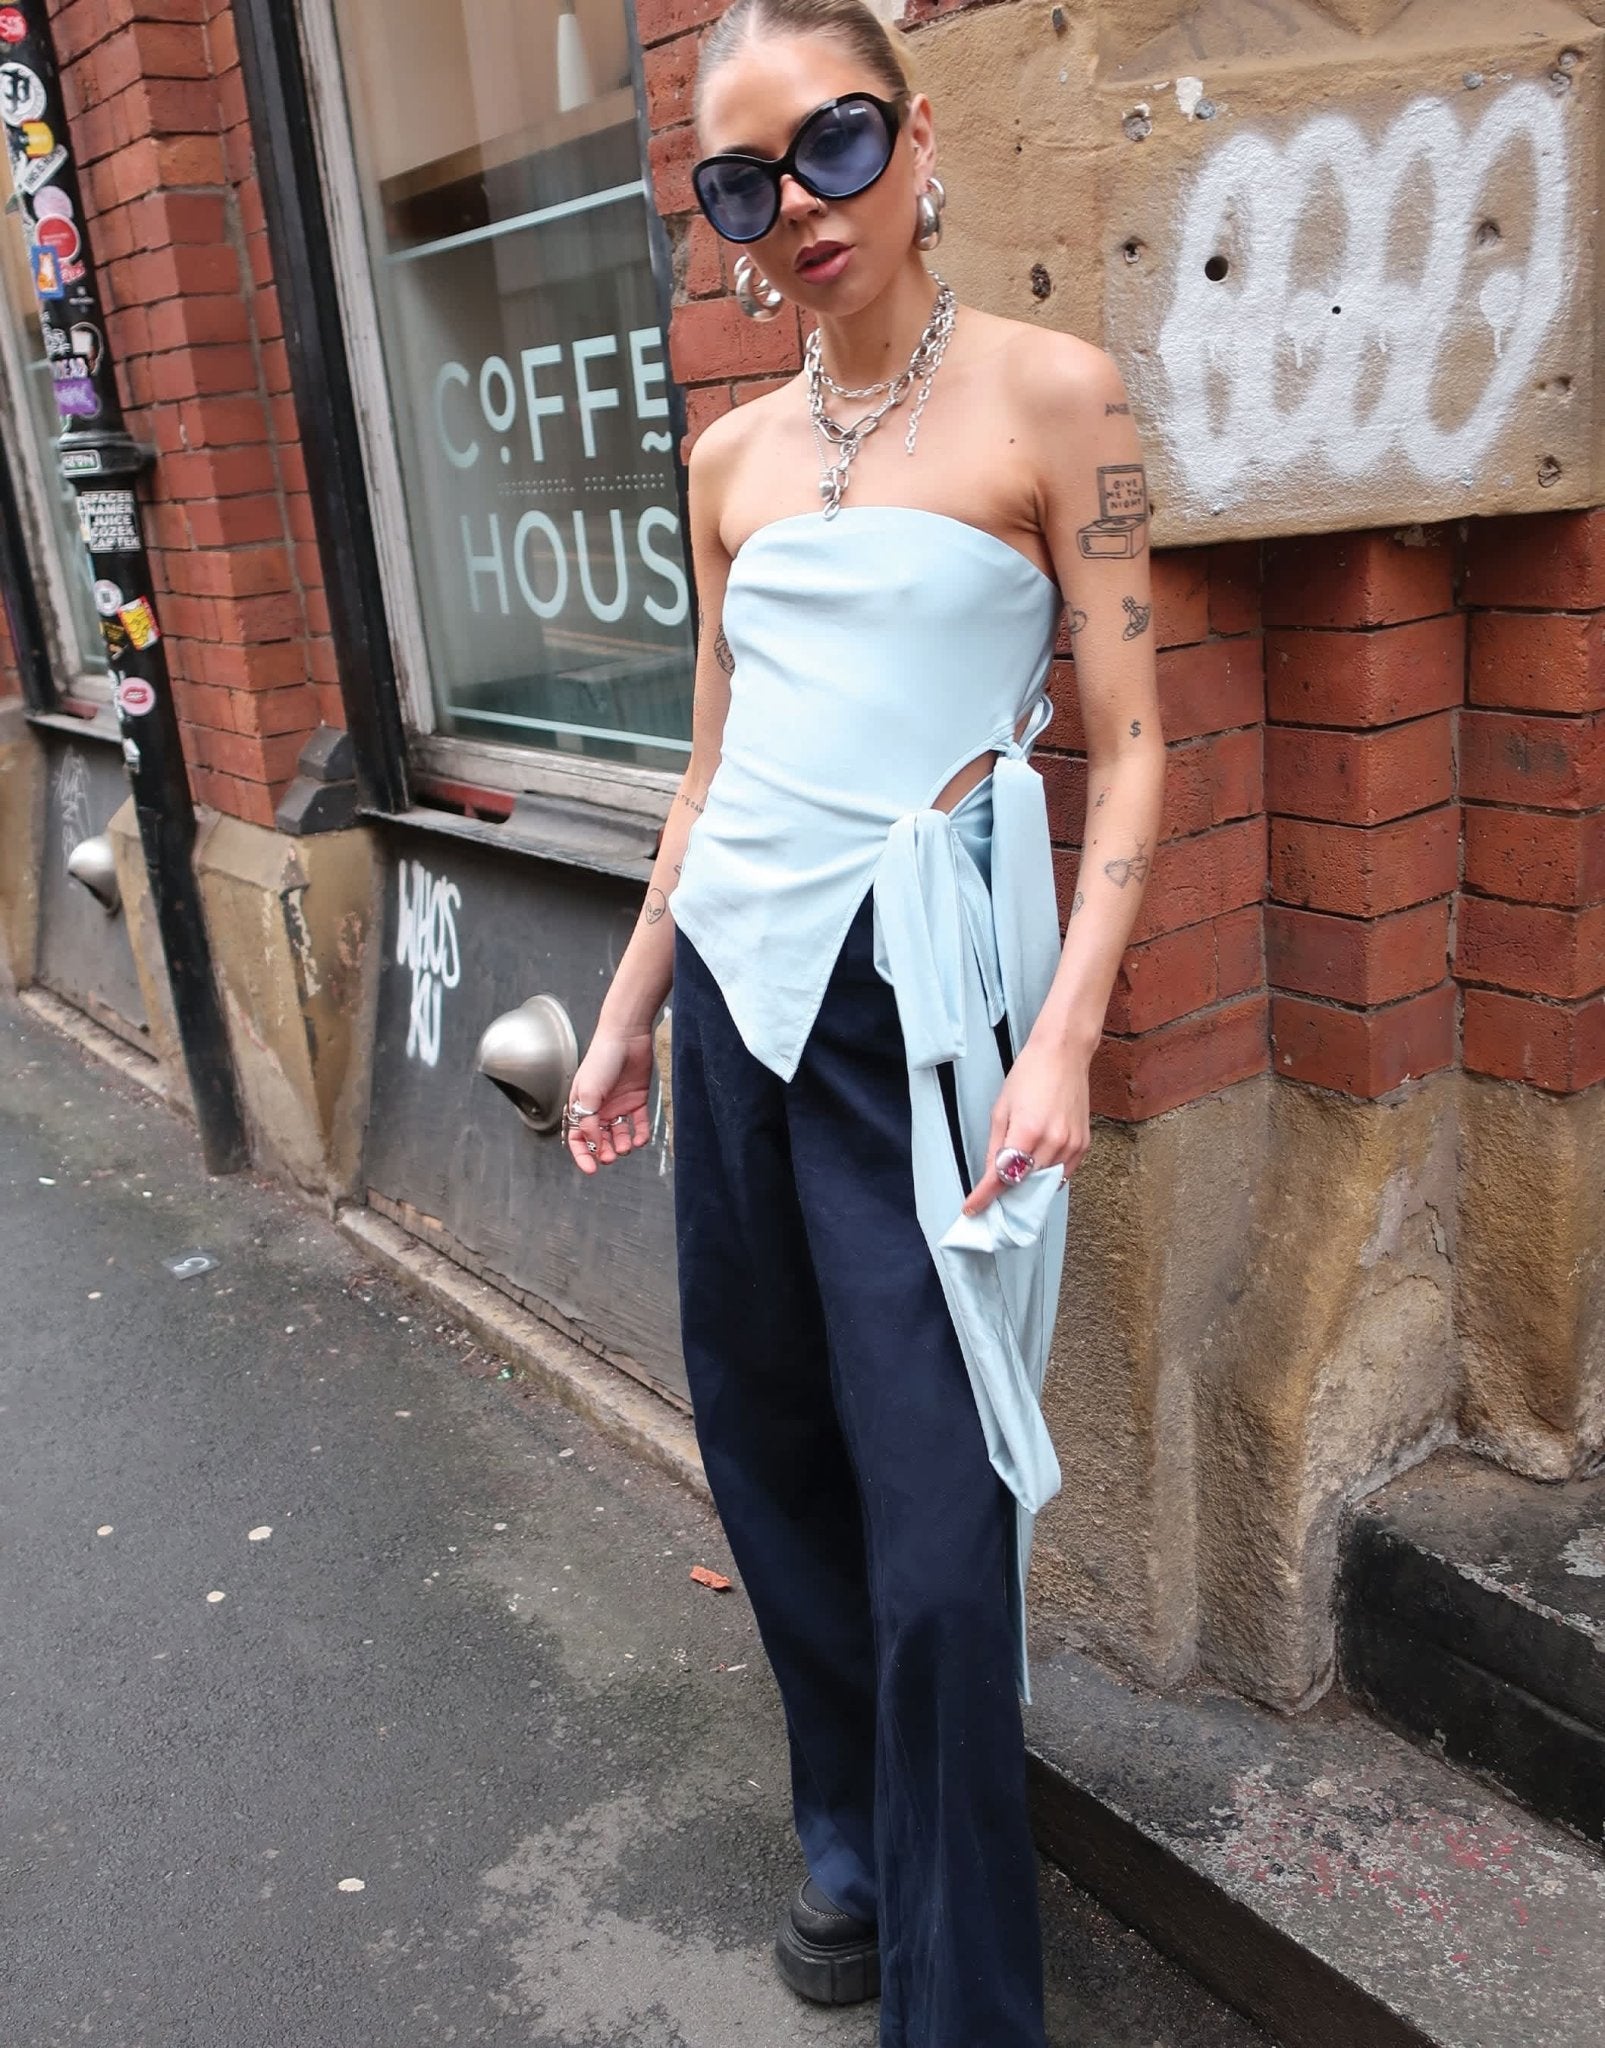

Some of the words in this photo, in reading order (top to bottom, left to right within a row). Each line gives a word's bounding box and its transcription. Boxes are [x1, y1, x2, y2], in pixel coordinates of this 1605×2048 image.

[1113, 478, 1137, 490] GIVE
[1106, 490, 1122, 500] ME
[1110, 498, 1142, 509] NIGHT
[460, 506, 690, 627] HOUS
